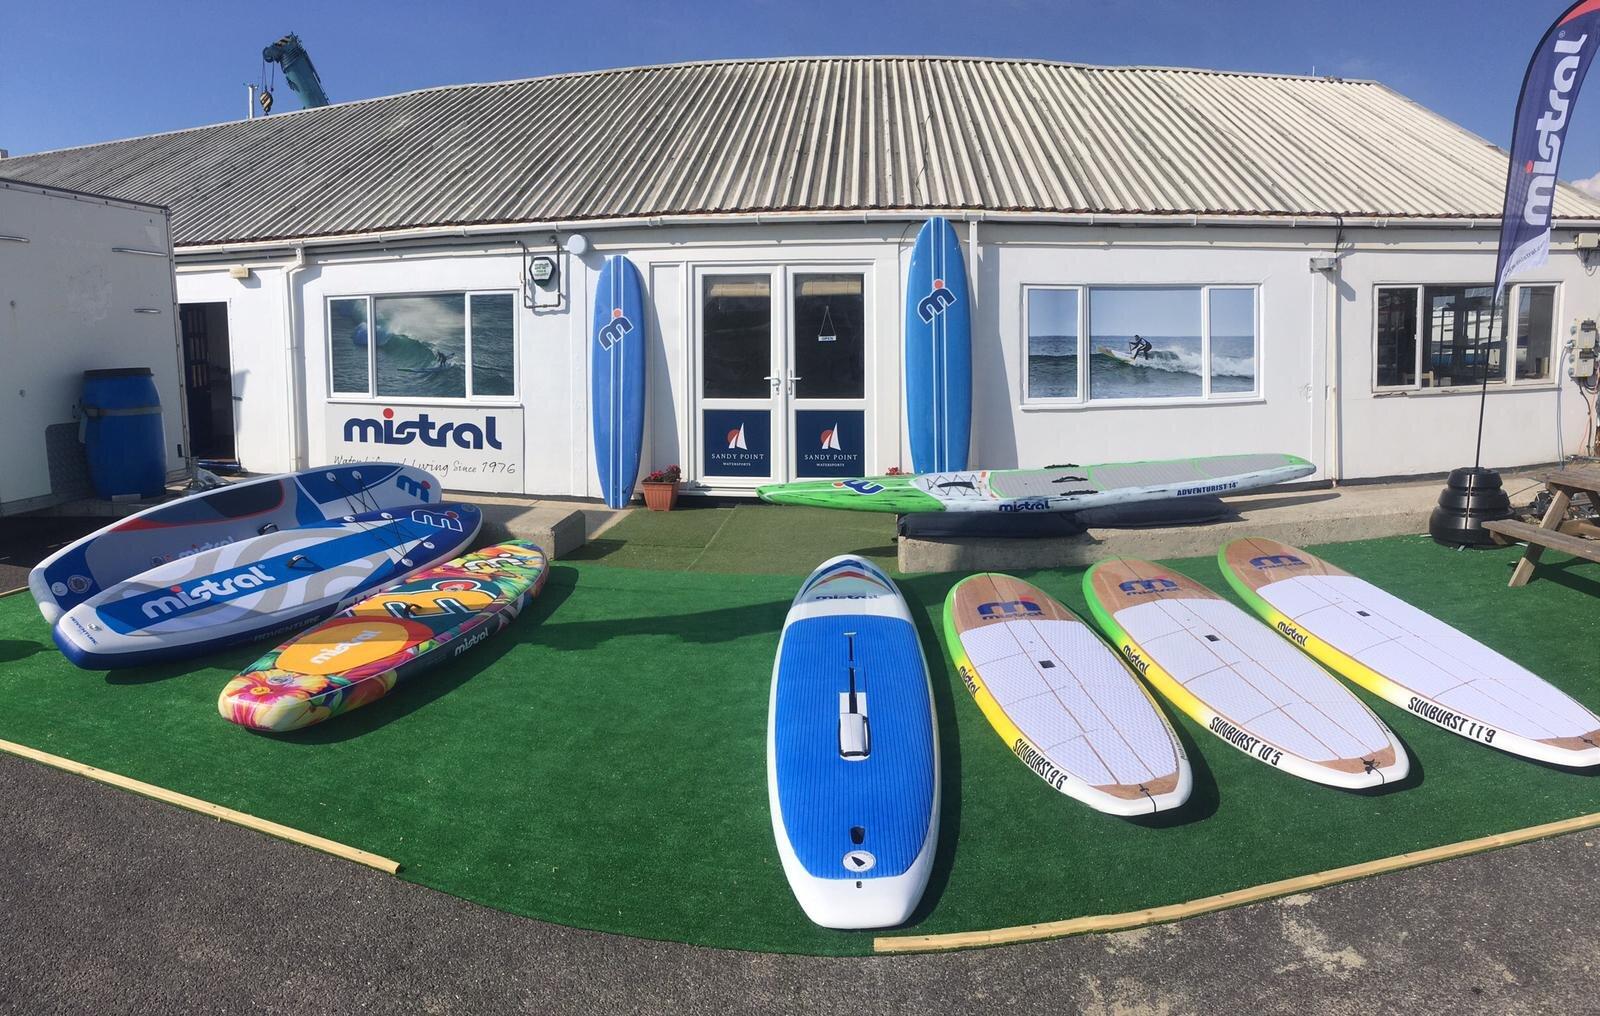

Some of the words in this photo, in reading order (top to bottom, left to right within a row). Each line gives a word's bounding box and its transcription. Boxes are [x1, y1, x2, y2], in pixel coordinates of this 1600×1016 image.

[1524, 33, 1587, 226] mistral
[343, 408, 502, 450] mistral
[453, 460, 477, 473] Since
[482, 461, 515, 474] 1976
[1177, 483, 1227, 496] ADVENTURIST
[999, 500, 1050, 512] mistral
[455, 627, 489, 656] mistral
[1277, 621, 1308, 647] mistral
[1123, 644, 1150, 675] mistral
[960, 665, 980, 698] mistral
[1408, 696, 1468, 731] SUNBURST
[1469, 722, 1496, 743] 11'9
[1209, 716, 1260, 753] SUNBURST
[1258, 744, 1283, 766] 10'5
[1012, 738, 1054, 779] SUNBURST
